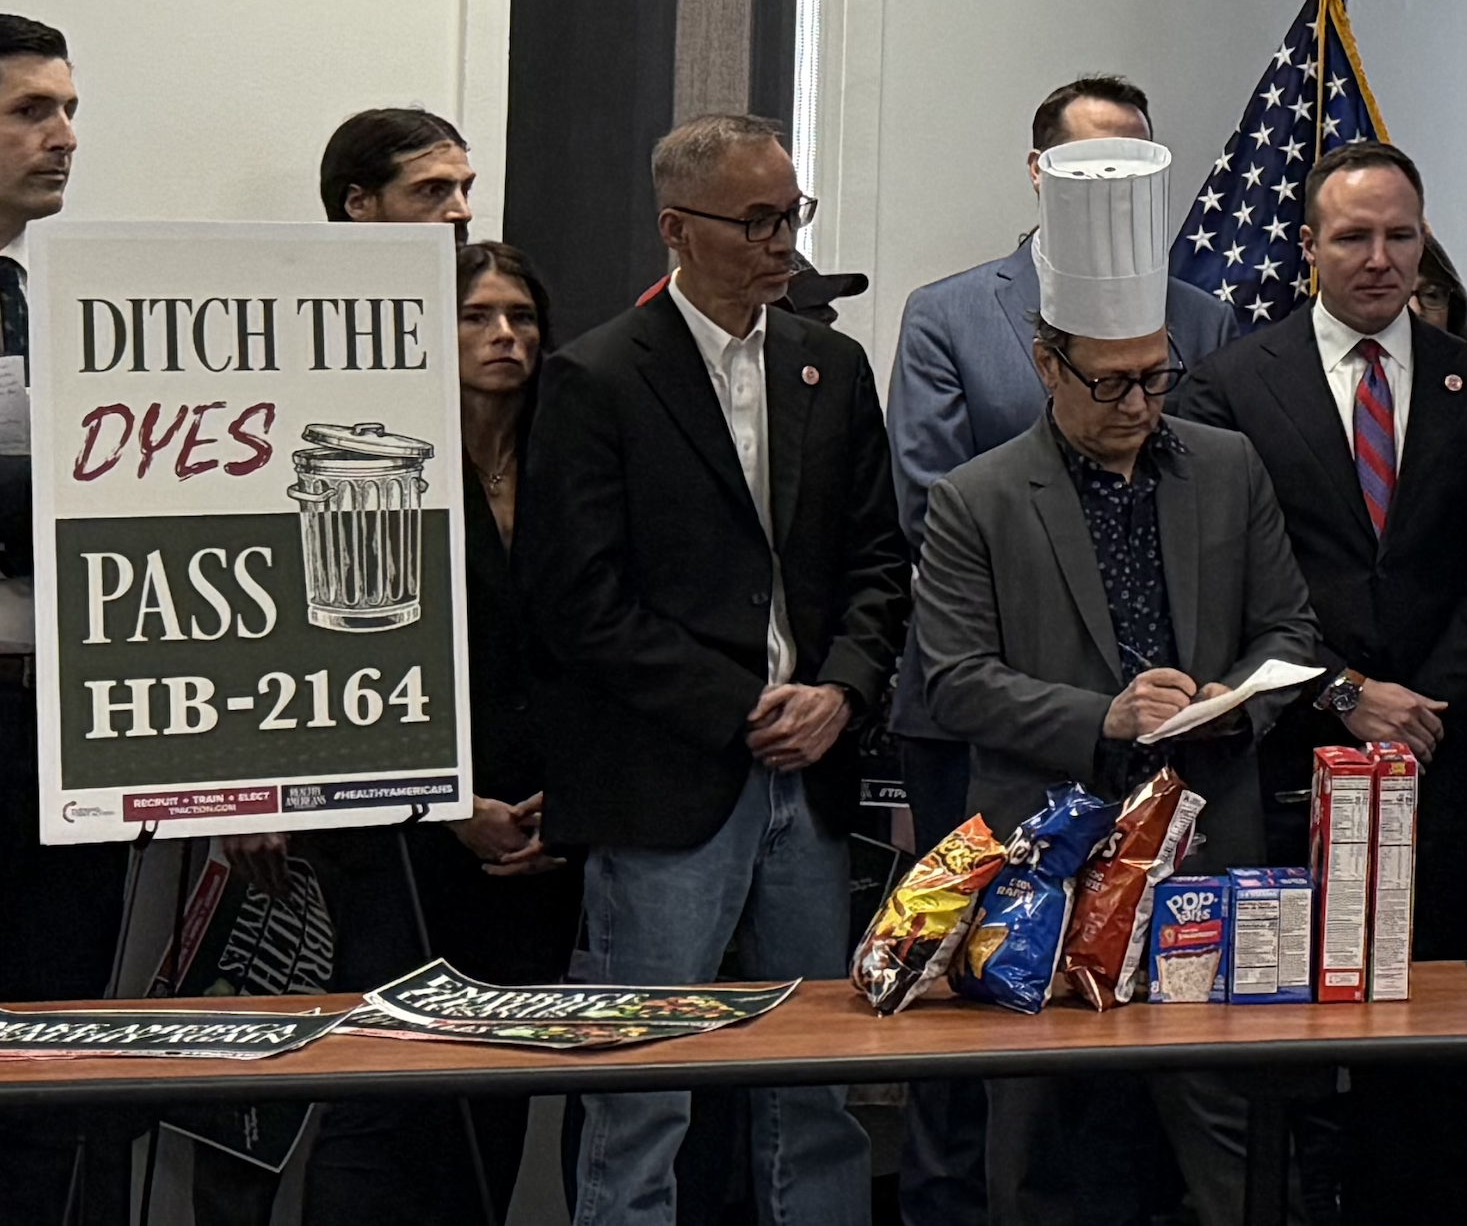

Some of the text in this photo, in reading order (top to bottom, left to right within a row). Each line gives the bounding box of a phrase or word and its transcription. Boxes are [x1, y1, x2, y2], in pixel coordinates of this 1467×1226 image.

[78, 298, 427, 374] DITCH THE
[73, 401, 276, 482] DYES
[80, 547, 277, 645] PASS
[85, 666, 430, 741] HB-2164
[133, 791, 270, 809] RECRUIT TRAIN ELECT
[333, 784, 454, 800] #HEALTHYAMERICANS
[288, 875, 334, 994] EMBRA
